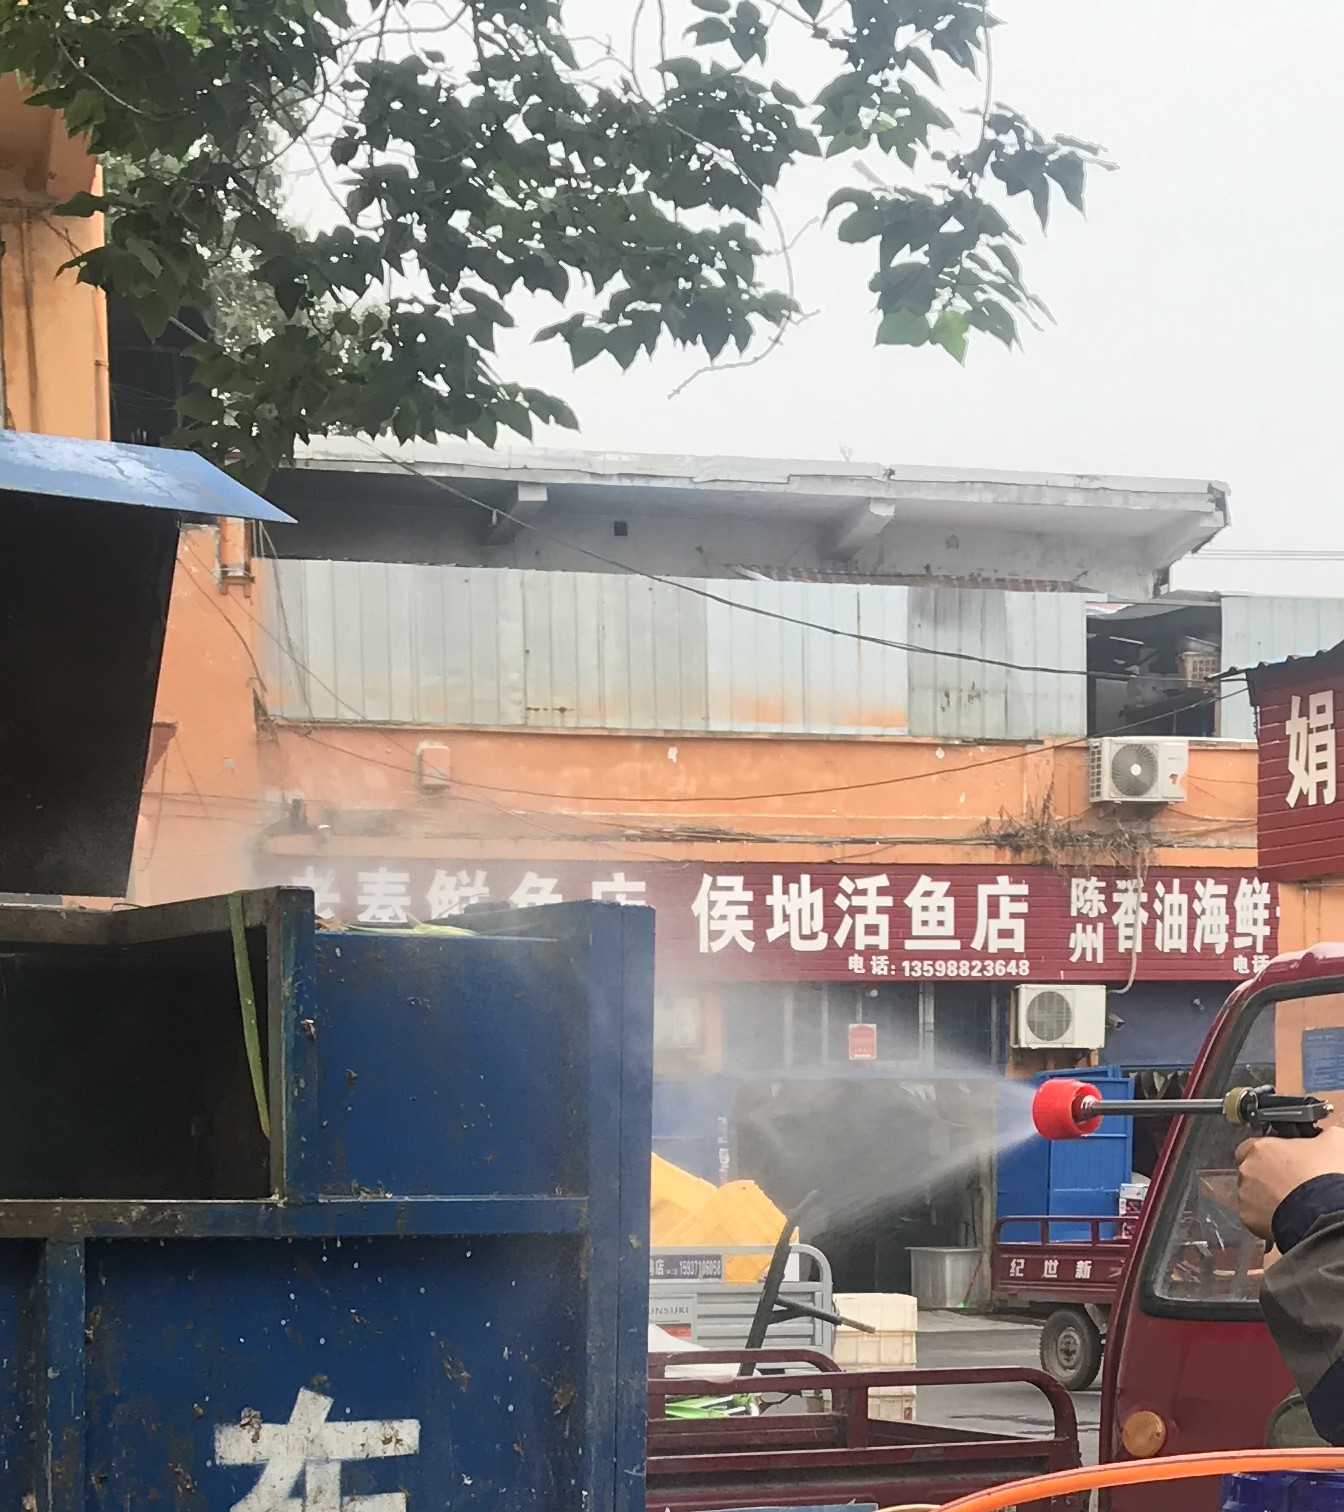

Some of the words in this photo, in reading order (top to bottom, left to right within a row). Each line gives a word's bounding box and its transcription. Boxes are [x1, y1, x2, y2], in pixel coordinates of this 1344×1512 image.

[691, 873, 1029, 953] 侯地活鱼店
[1068, 876, 1108, 963] 陈州
[1112, 876, 1271, 954] 香油海鲜
[901, 960, 1030, 977] 13598823648
